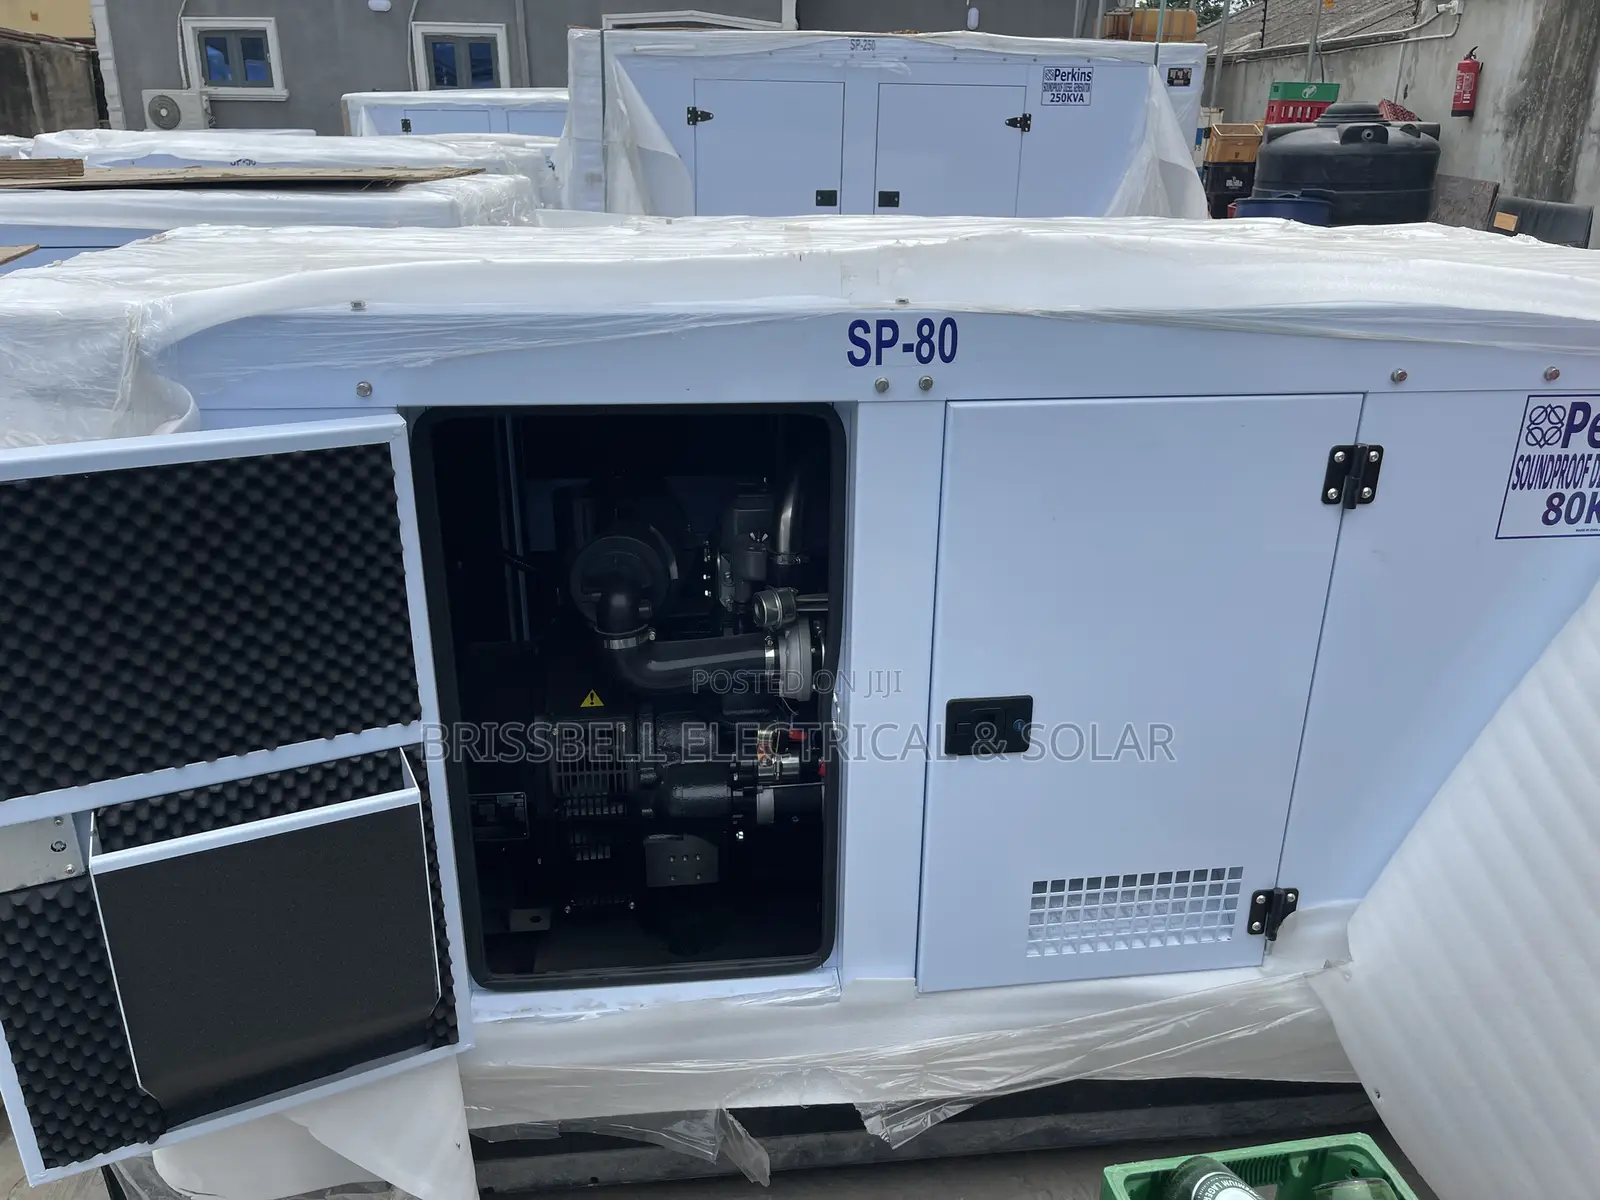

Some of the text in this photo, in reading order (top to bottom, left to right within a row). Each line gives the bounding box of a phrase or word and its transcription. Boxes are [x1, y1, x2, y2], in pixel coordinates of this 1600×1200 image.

[1054, 68, 1092, 82] Perkins
[1050, 93, 1084, 103] 250KVA
[847, 317, 958, 367] SP-80
[1511, 453, 1593, 490] SOUNDPROOF
